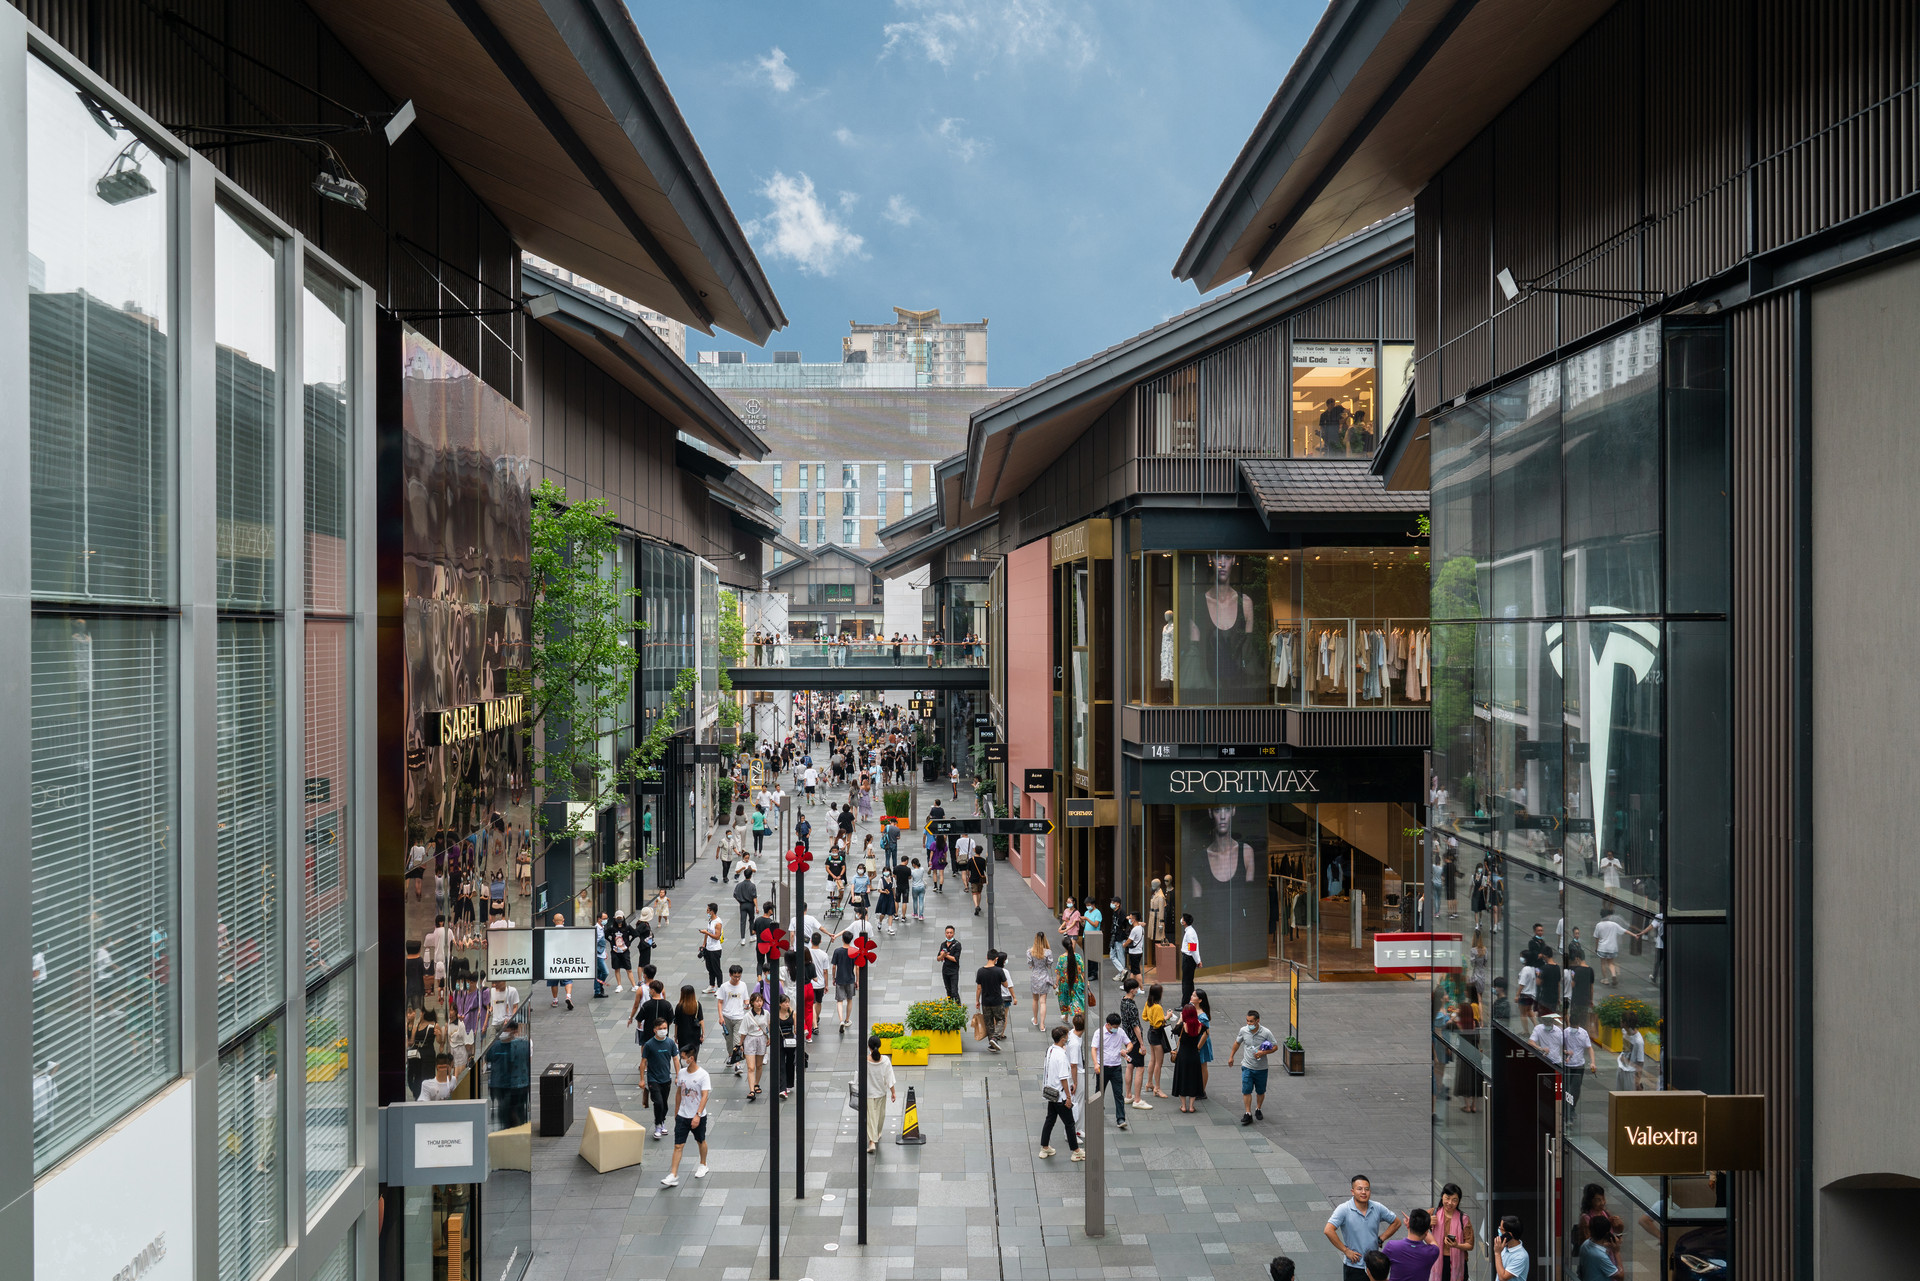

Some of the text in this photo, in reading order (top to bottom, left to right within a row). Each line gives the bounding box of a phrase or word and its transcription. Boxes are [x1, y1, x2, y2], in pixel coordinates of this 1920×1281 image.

[440, 695, 524, 746] ISABEL MARANT
[1169, 770, 1320, 793] SPORTMAX
[549, 966, 590, 974] MARANT
[552, 957, 587, 965] ISABEL
[1624, 1125, 1698, 1146] Valextra
